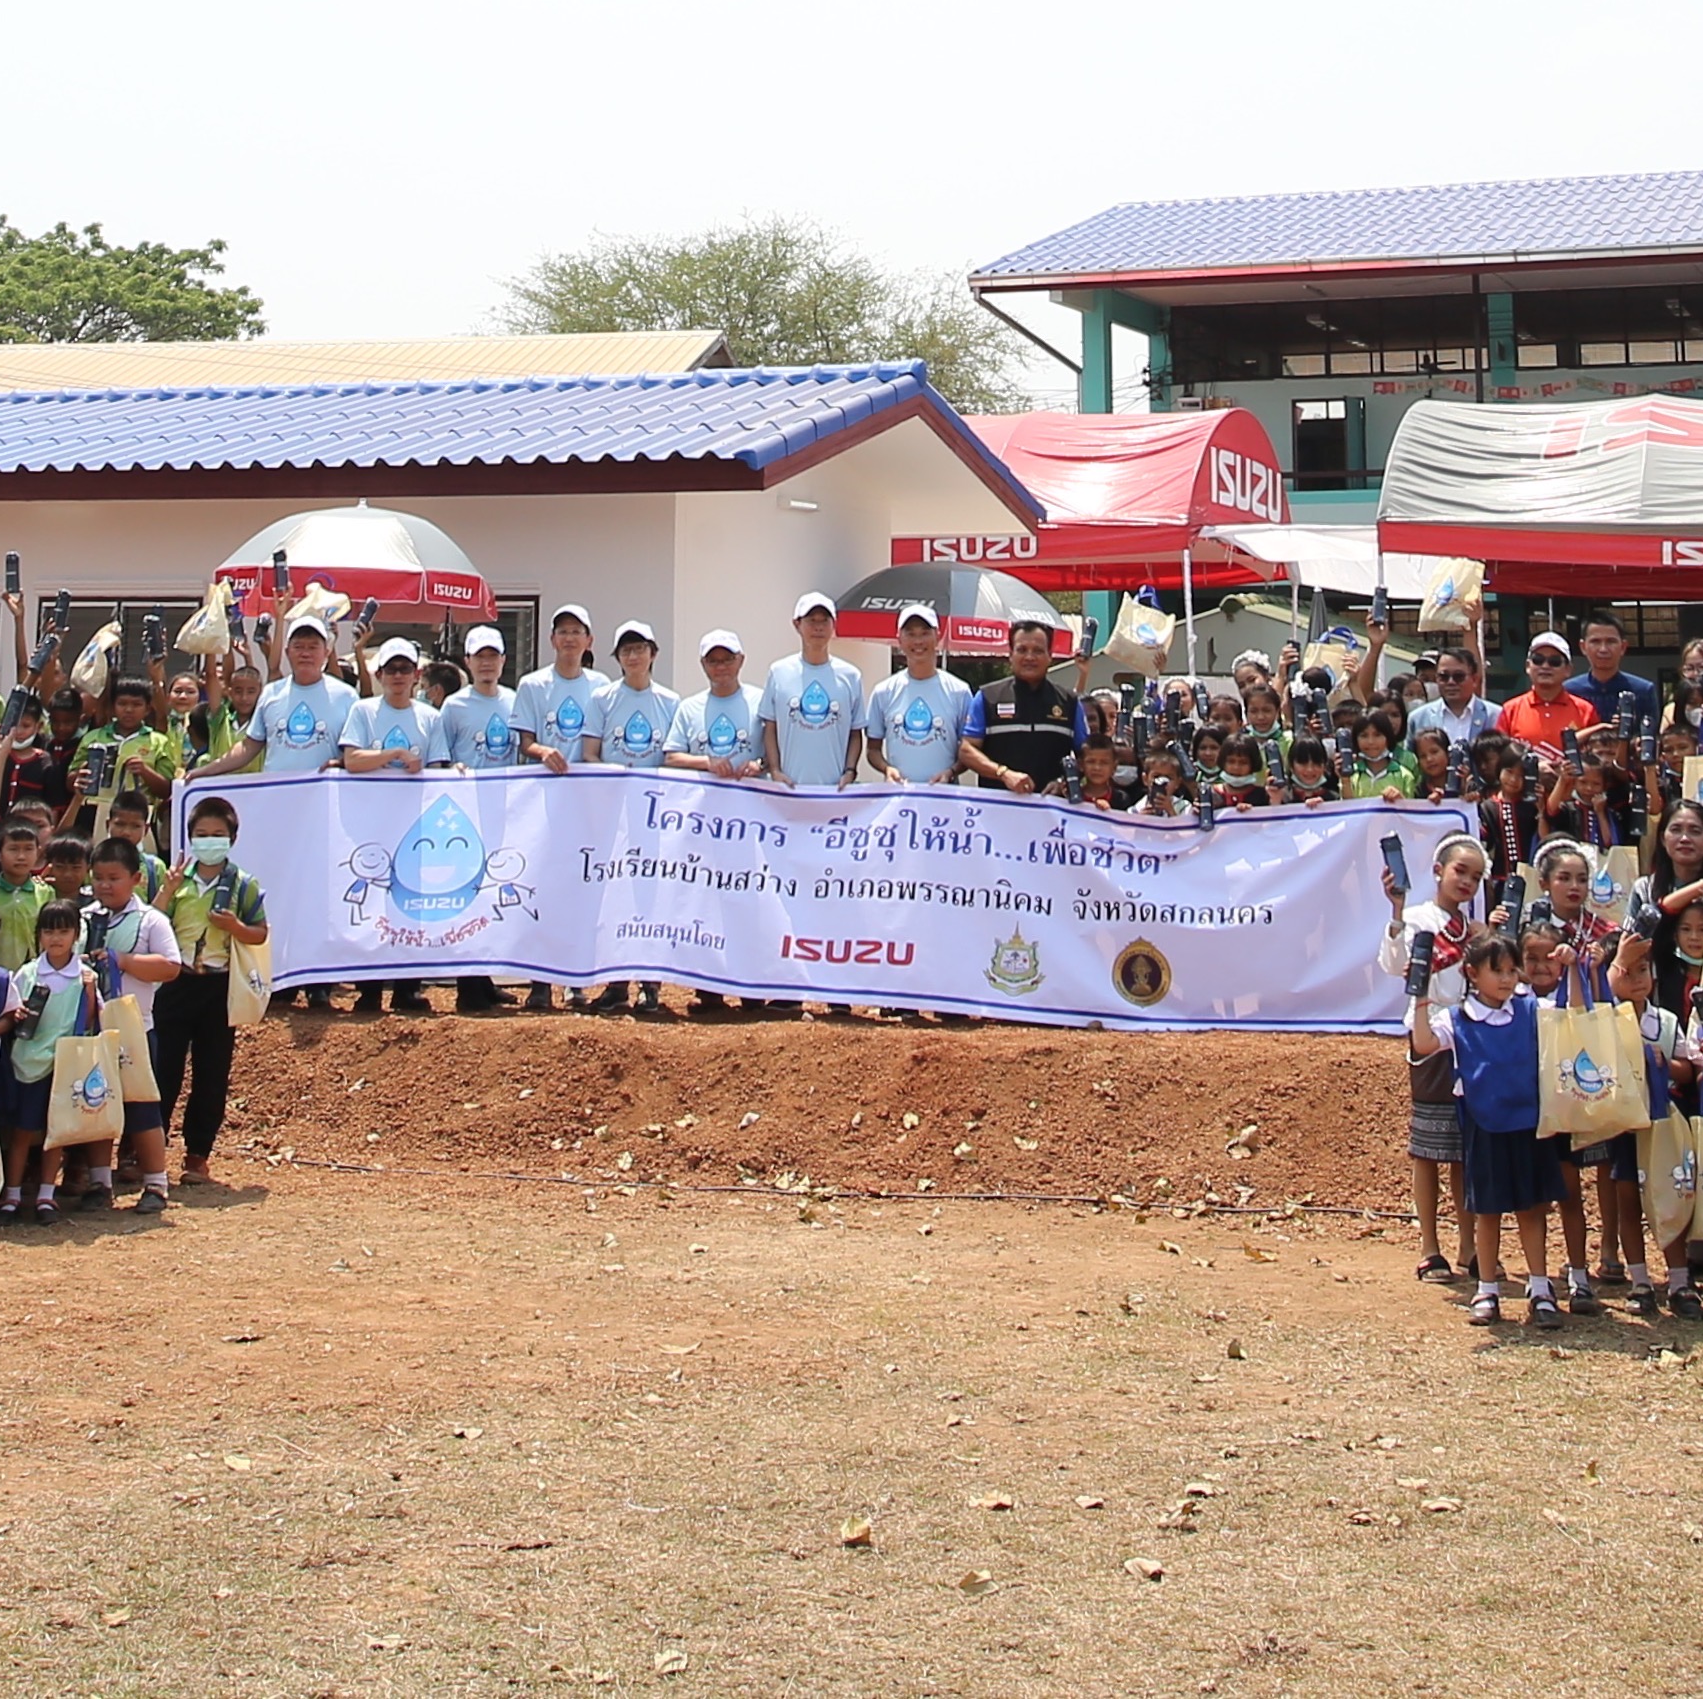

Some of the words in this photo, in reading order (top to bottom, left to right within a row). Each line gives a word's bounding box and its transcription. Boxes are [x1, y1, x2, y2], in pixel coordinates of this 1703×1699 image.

[1210, 445, 1282, 524] ISUZU
[922, 536, 1038, 562] ISUZU
[433, 582, 472, 600] ISUZU
[958, 624, 1003, 639] ISUZU
[643, 791, 789, 848] โครงการ
[580, 847, 798, 898] โรงเรียนบ้านสว่าง
[814, 868, 1052, 916] อำเภอพรรณานิคม
[1073, 888, 1273, 926] จังหวัดสกลนคร
[403, 897, 465, 911] ISUZU
[616, 916, 726, 951] สนับสนุนโดย
[780, 935, 915, 966] ISUZU
